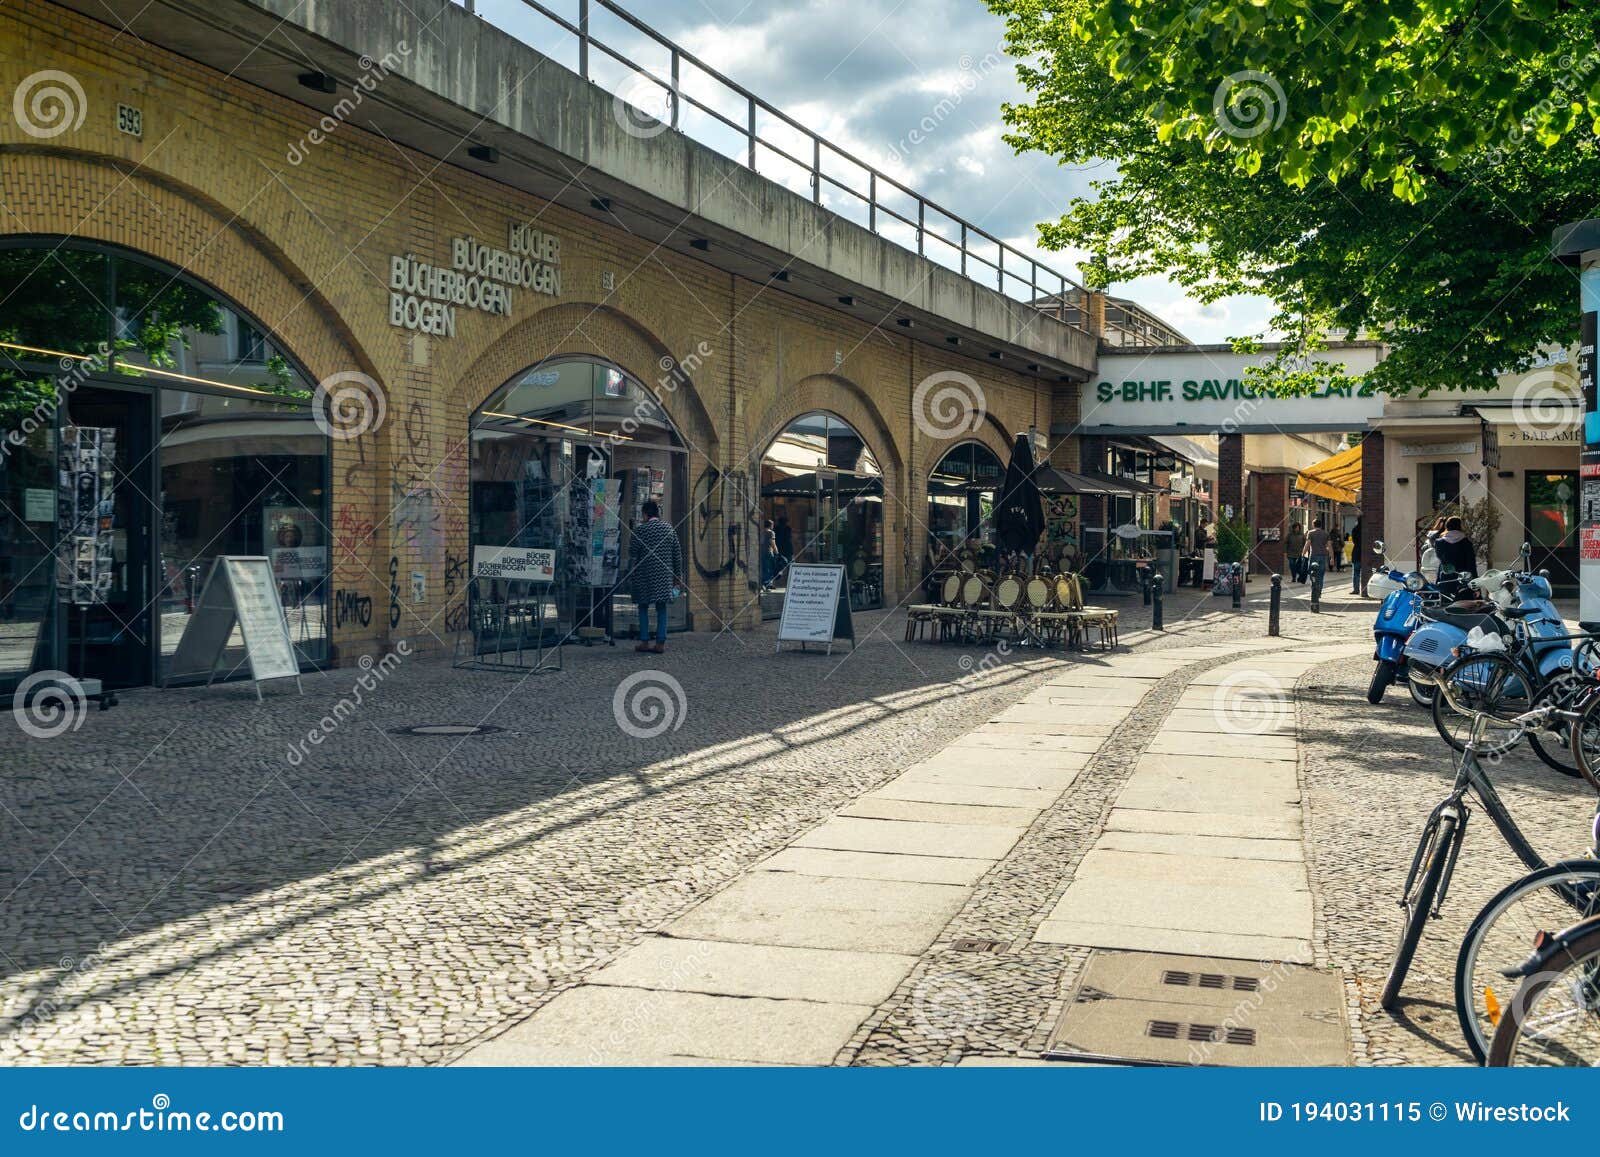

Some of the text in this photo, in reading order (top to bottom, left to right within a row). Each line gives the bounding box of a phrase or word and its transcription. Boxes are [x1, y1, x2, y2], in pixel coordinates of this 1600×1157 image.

[119, 105, 140, 134] 593
[509, 222, 562, 265] BÜCHER
[452, 236, 562, 297] BÜCHERBOGEN
[390, 253, 512, 317] BÜCHERBOGEN
[390, 292, 456, 338] BOGEN
[1096, 380, 1174, 403] S-BHF.
[1522, 431, 1549, 441] BAR
[478, 561, 526, 571] BÜCHERBOGEN
[502, 556, 550, 566] BÜCHERBOGEN
[526, 552, 550, 560] BÜCHER
[478, 568, 502, 576] BOGEN
